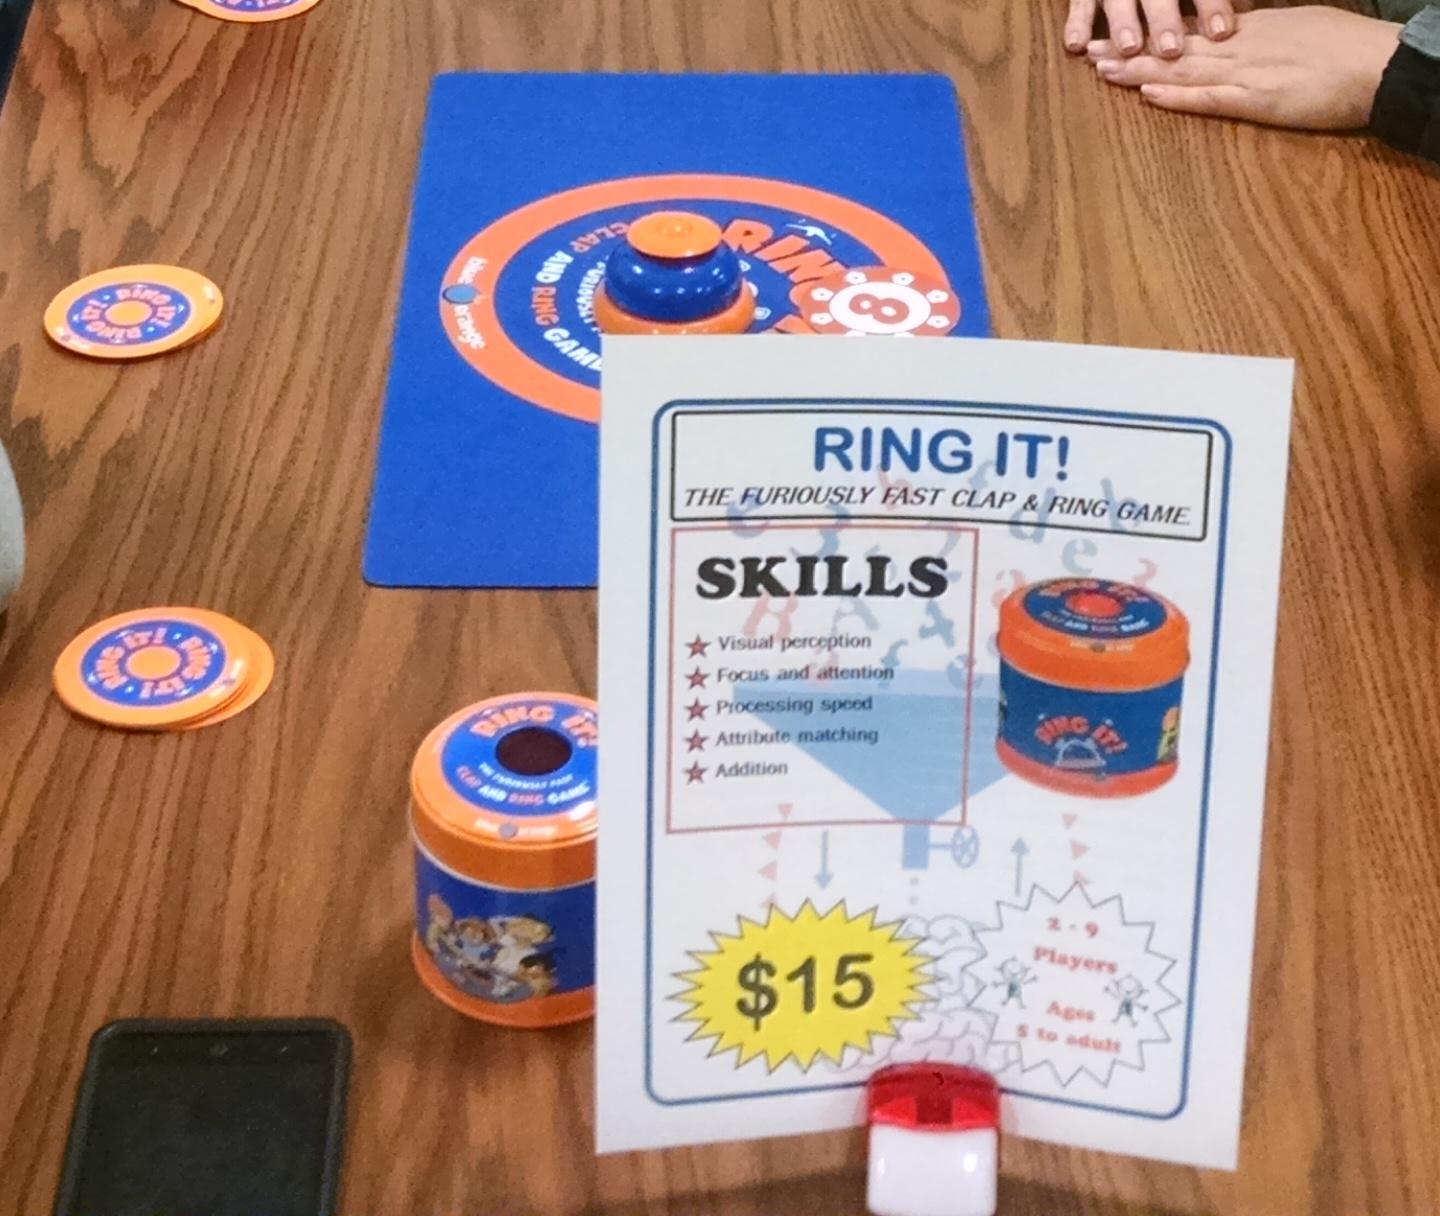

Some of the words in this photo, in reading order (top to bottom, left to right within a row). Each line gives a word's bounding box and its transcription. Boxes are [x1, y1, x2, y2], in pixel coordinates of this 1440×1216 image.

[569, 222, 630, 253] CLAP
[536, 250, 574, 284] AND
[530, 286, 560, 326] RING
[814, 427, 973, 474] RING
[995, 431, 1070, 481] IT!
[684, 488, 734, 507] THE
[740, 486, 875, 505] FURIOUSLY
[881, 486, 945, 506] FAST
[951, 489, 1016, 510] CLAP
[1022, 494, 1039, 512] &
[1048, 496, 1109, 518] RING
[1116, 502, 1192, 526] GAME
[696, 556, 949, 599] SKILLS
[717, 635, 773, 651] Visual
[781, 634, 872, 652] perception
[717, 667, 769, 682] Focus
[776, 666, 810, 681] and
[817, 664, 895, 680] attention
[716, 698, 813, 715] Processing
[820, 696, 873, 713] speed
[469, 704, 555, 738] RING
[715, 729, 791, 746] Attribute
[797, 727, 879, 745] matching
[715, 761, 788, 778] Addition
[1046, 915, 1062, 931] 2
[1084, 921, 1100, 938] 9
[1033, 945, 1119, 975] Players
[736, 952, 875, 1031] $15
[1045, 1000, 1096, 1022] Ages
[1037, 1027, 1058, 1042] to
[1066, 1033, 1122, 1054] adult
